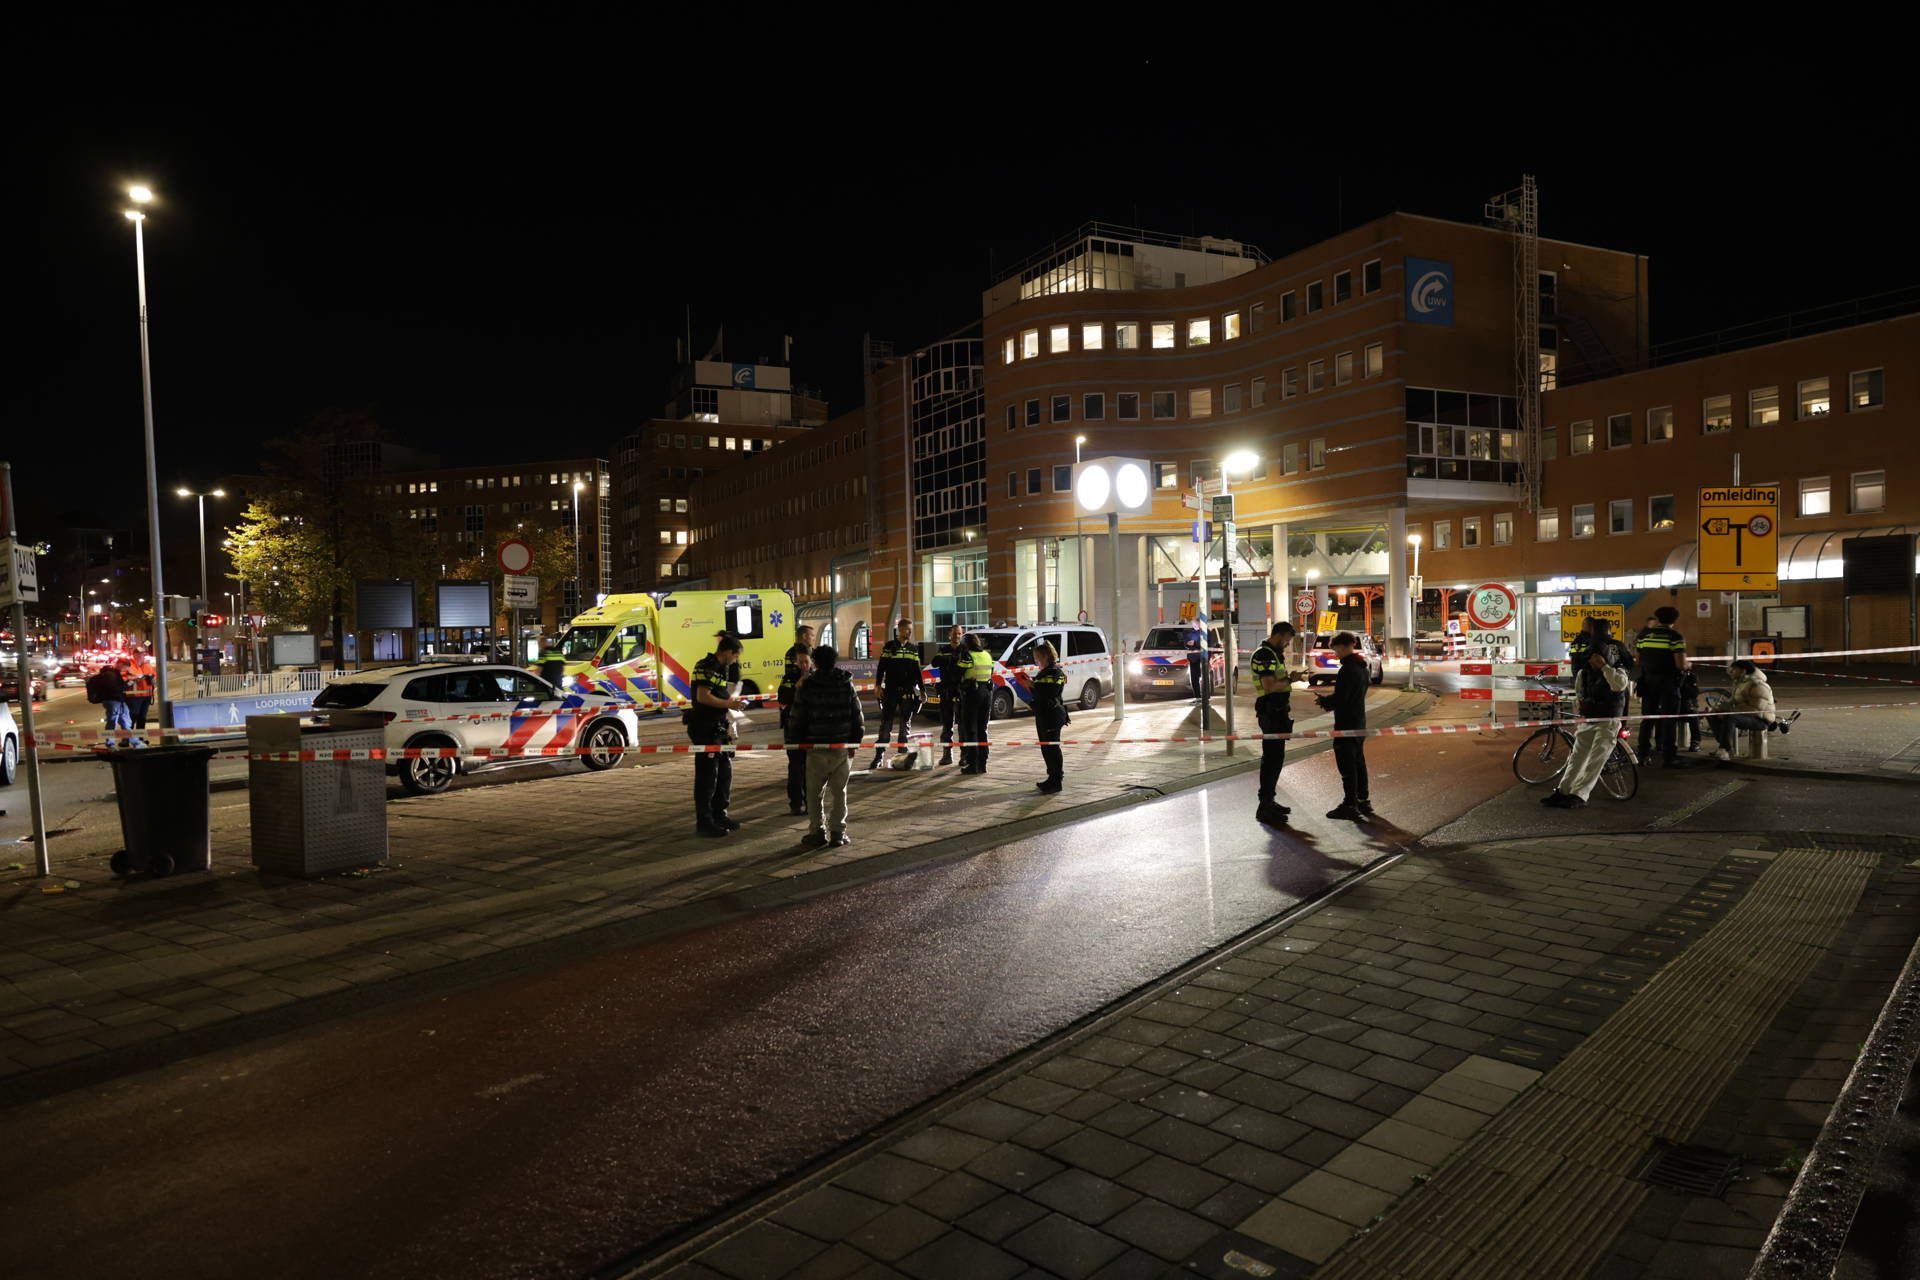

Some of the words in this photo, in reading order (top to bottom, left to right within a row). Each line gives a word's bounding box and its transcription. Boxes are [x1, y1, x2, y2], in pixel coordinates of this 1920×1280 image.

[1702, 489, 1775, 504] omleiding
[1563, 609, 1578, 617] NS
[1580, 608, 1619, 617] fietsen-
[1473, 633, 1510, 645] 40m
[256, 697, 308, 709] LOOPROUTE
